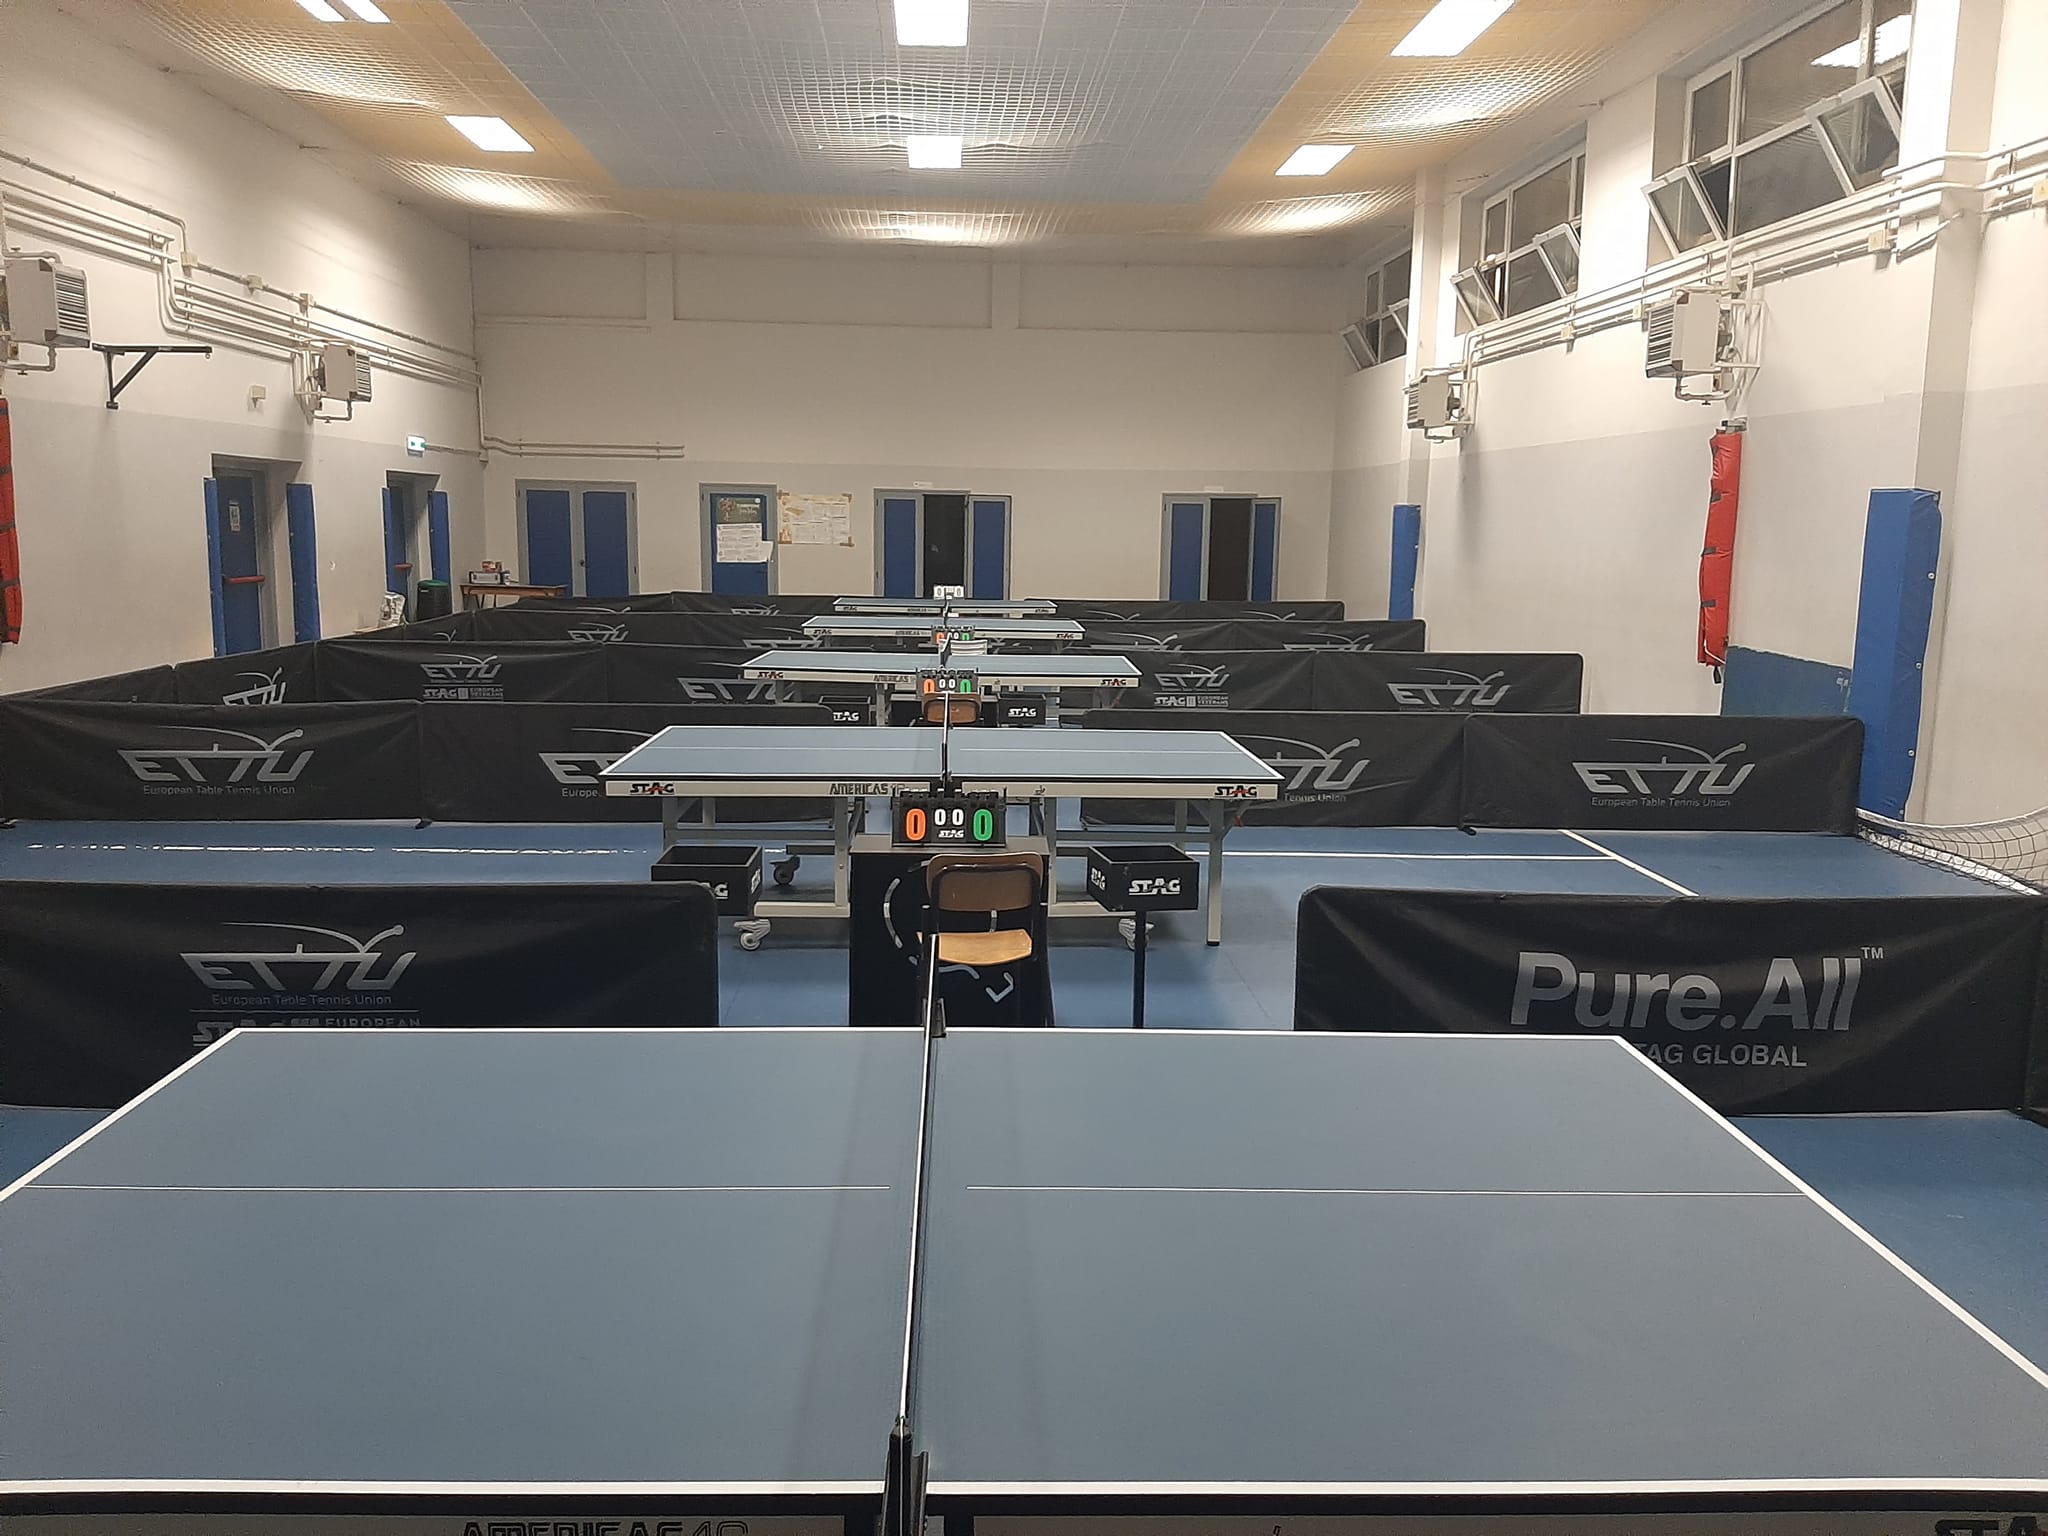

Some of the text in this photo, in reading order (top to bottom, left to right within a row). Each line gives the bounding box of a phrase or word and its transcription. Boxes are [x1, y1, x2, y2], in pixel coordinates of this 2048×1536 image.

[420, 663, 502, 678] ETTU
[1100, 678, 1127, 686] STAG
[1154, 673, 1230, 687] ETTU
[1387, 683, 1512, 706] ETTU
[1008, 707, 1037, 718] STAG
[117, 749, 315, 783] ETTU
[1572, 761, 1756, 795] ETTU
[561, 787, 600, 799] Europe
[630, 782, 675, 796] STAG
[829, 783, 889, 795] AMERICAS
[1214, 784, 1258, 798] STAG
[1591, 797, 1639, 808] European
[905, 808, 993, 842] 0 0 0 0
[1128, 878, 1181, 896] STAG
[179, 951, 417, 991] ETTU
[1510, 951, 1862, 1032] Pure.All
[212, 993, 392, 1007] European Table Tennis Union
[325, 1017, 421, 1028] EUROPEAN
[1692, 1043, 1808, 1068] GLOBAL
